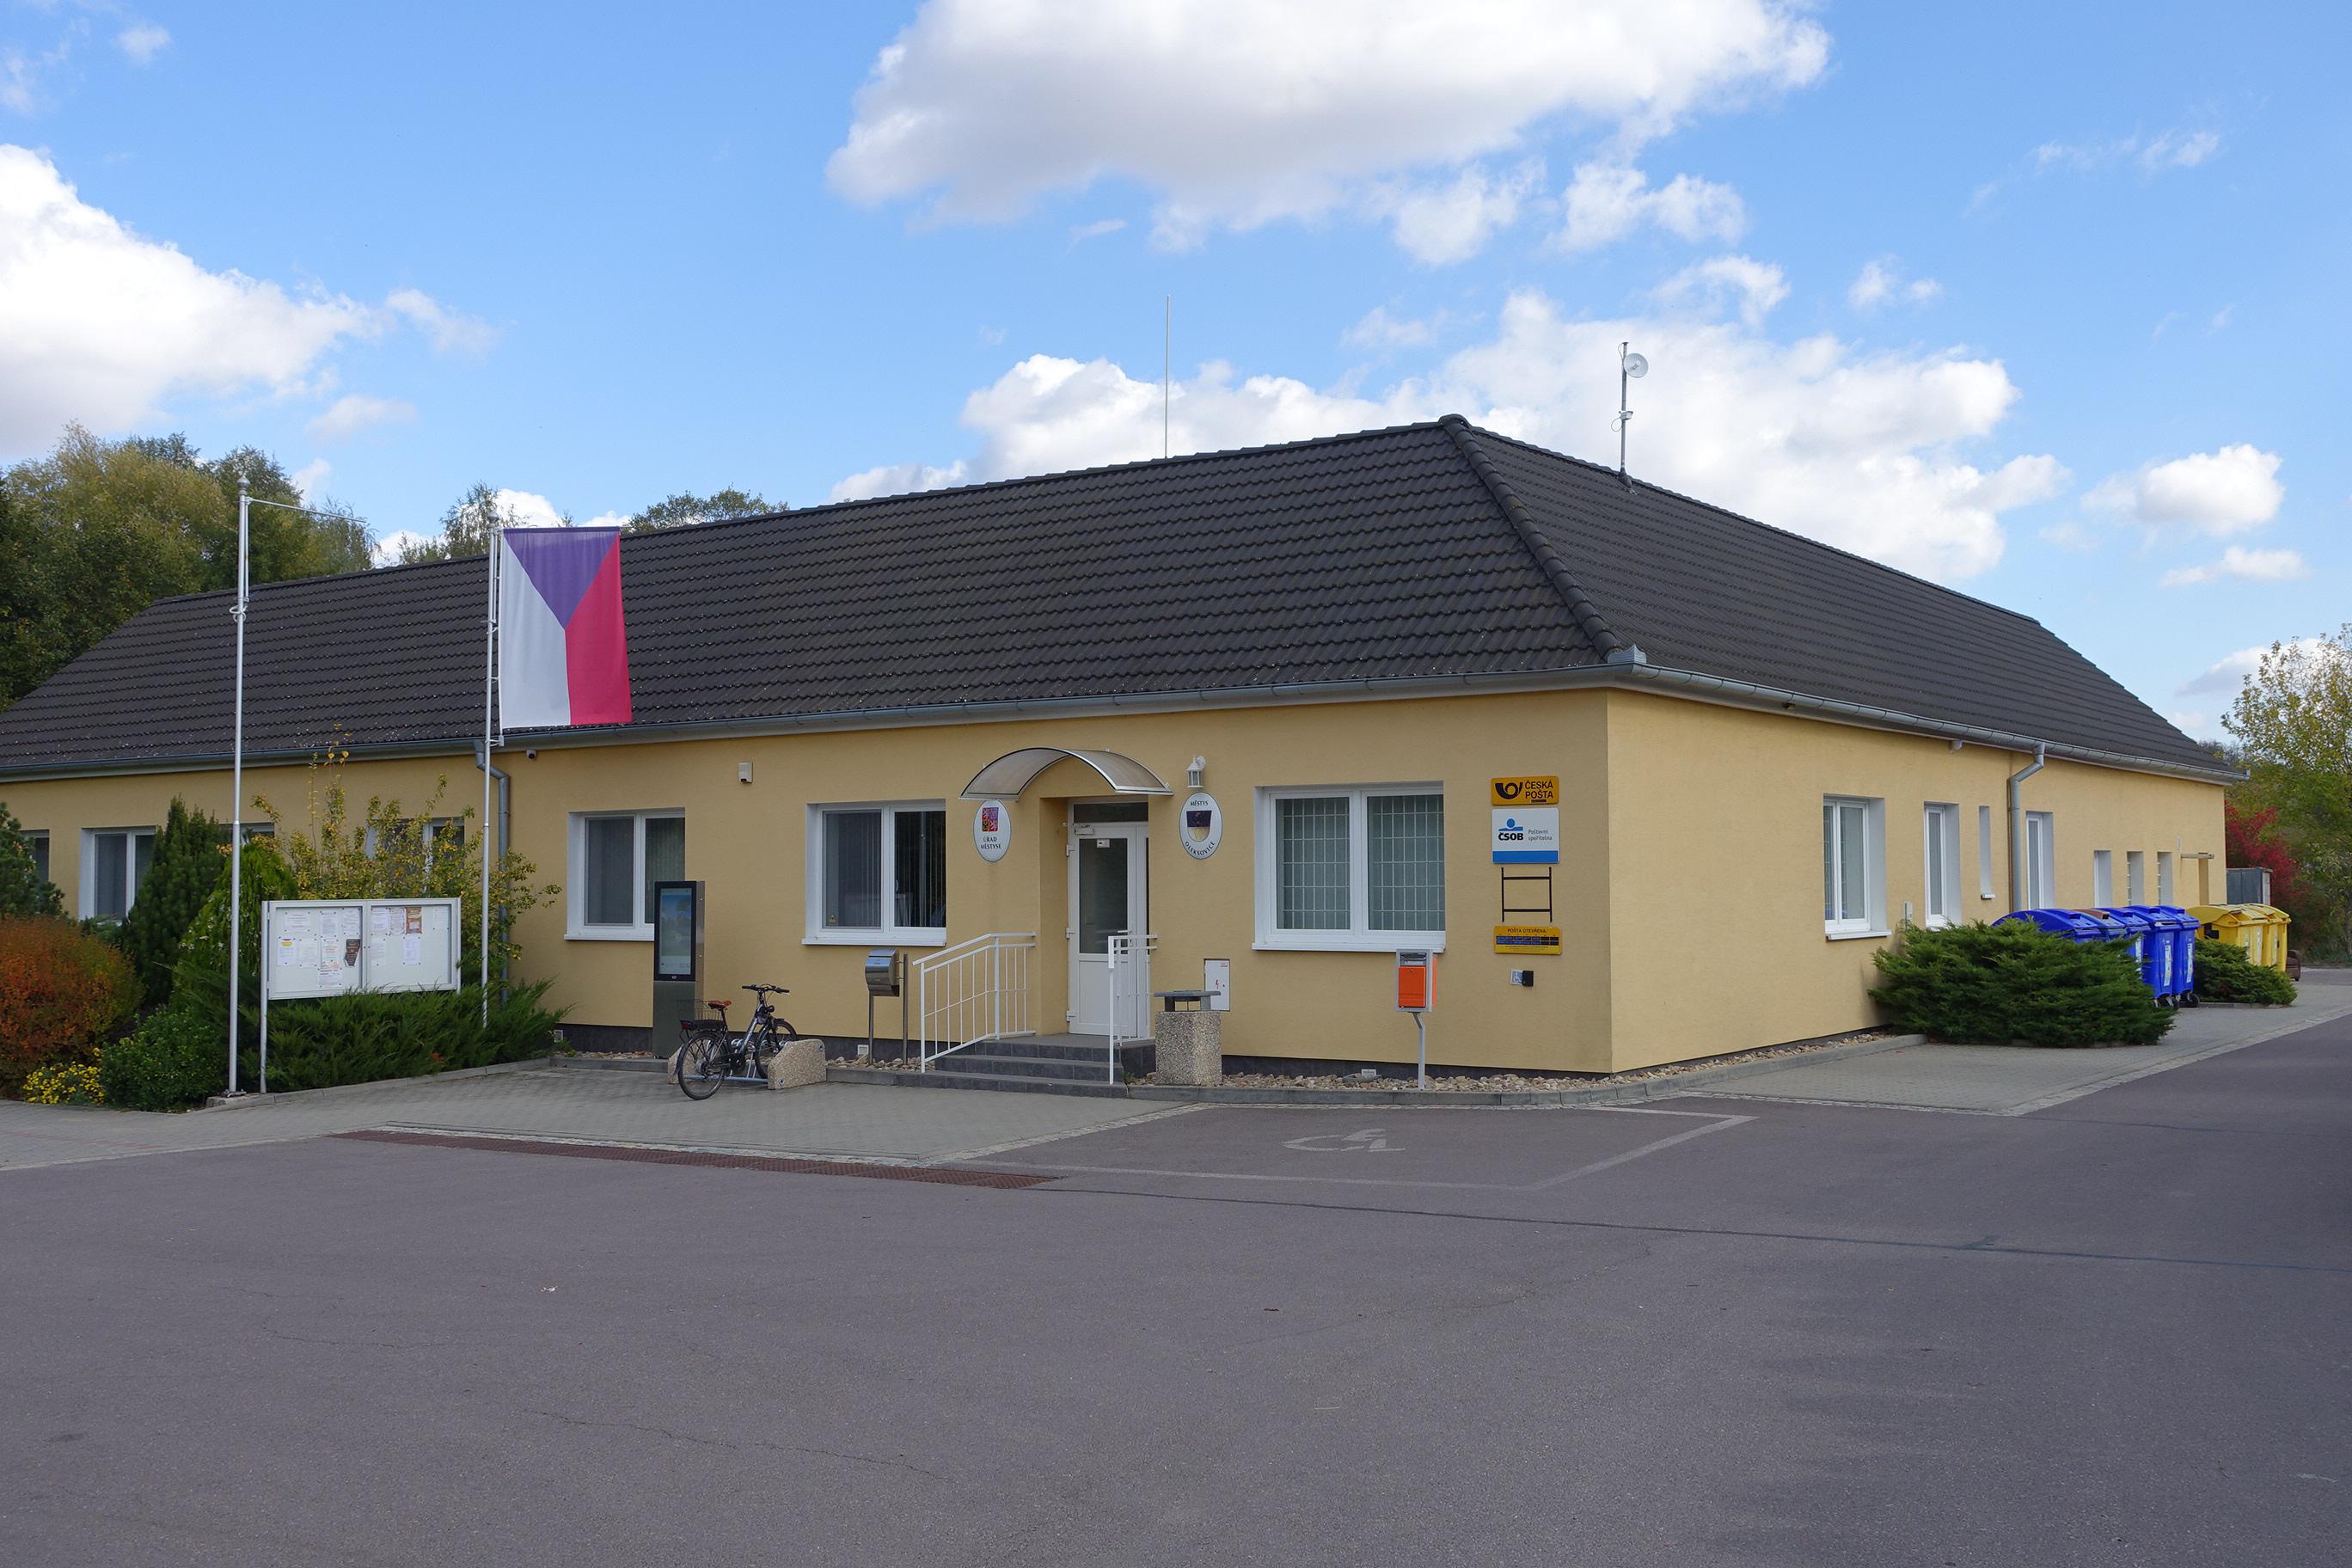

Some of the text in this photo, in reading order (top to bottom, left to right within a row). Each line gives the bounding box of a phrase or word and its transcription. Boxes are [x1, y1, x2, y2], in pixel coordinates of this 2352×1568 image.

[1525, 780, 1553, 789] ČESKÁ
[1525, 790, 1553, 799] POŠTA
[1498, 832, 1524, 841] ČSOB
